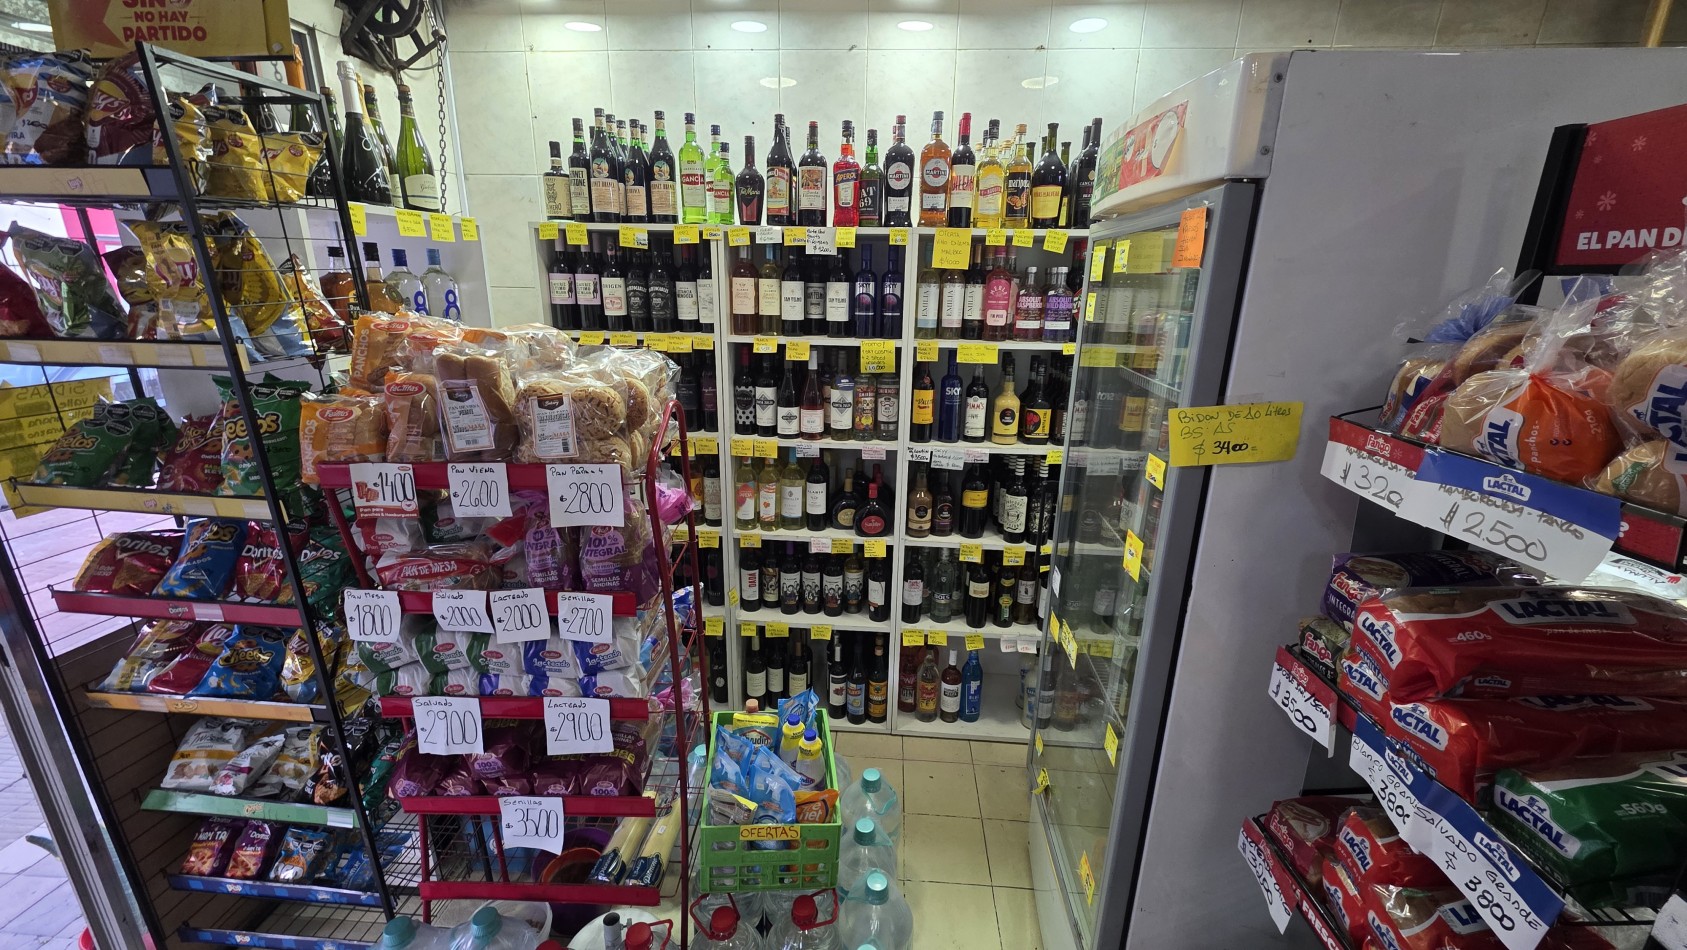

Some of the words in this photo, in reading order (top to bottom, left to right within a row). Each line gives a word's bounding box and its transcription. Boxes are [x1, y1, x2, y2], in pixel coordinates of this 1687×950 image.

[134, 12, 154, 22] NO
[158, 11, 188, 22] HAY
[122, 25, 207, 42] PARTIDO
[682, 175, 705, 185] GANCIA
[836, 172, 856, 183] APEROL
[714, 190, 730, 198] ANCIA
[860, 186, 876, 197] AT
[859, 198, 872, 207] 69
[938, 230, 960, 238] OFERTA
[1577, 232, 1602, 250] EL
[1605, 228, 1658, 249] PAN
[444, 289, 461, 321] 8
[353, 328, 370, 378] PANCHOS
[945, 387, 961, 396] SKY
[966, 402, 985, 410] PIMM'S
[1228, 410, 1242, 421] DE
[57, 435, 96, 451] eetos
[304, 419, 318, 476] PANCHOS
[1193, 440, 1205, 465] $
[1340, 462, 1352, 485] $
[453, 480, 499, 508] $2600
[560, 482, 614, 514] $2800
[1487, 478, 1527, 499] LACTAL
[432, 524, 463, 539] Salvado
[588, 535, 619, 548] 100%
[1440, 501, 1460, 532] $
[1462, 511, 1548, 562] 2.500
[242, 545, 284, 560] Doritos
[401, 565, 418, 577] PAN
[419, 565, 430, 575] DE
[430, 560, 457, 573] MESA
[532, 570, 558, 578] SEMILLAS
[591, 575, 621, 583] SEMILLAS
[1328, 593, 1357, 618] INTEGRA
[1501, 600, 1620, 620] LACTAL
[349, 604, 392, 636] $1800
[439, 605, 482, 627] $2000
[497, 604, 541, 632] $2000
[562, 607, 604, 636] $2700
[1360, 615, 1399, 668] LACTAL
[219, 648, 275, 668] Cheetos
[373, 647, 404, 661] Salvado
[433, 650, 464, 662] Salvado
[478, 657, 511, 669] Salvado
[532, 658, 571, 669] Lacteado
[585, 650, 622, 667] Lacteado
[1477, 677, 1508, 687] LACTAL
[1272, 679, 1281, 698] $
[1281, 690, 1317, 734] 3500
[420, 710, 478, 746] $2900
[550, 711, 603, 742] $2900
[1391, 709, 1442, 747] ACTAL
[1388, 751, 1410, 785] LACTAL
[505, 808, 559, 839] $3500
[740, 826, 799, 839] OFERTAS
[1499, 789, 1568, 856] LACTAL
[1342, 831, 1373, 874] LACTAL
[1479, 836, 1515, 876] LACTAL
[1444, 850, 1457, 871] $
[1464, 875, 1515, 932] 3800
[1302, 899, 1342, 950] FRESC
